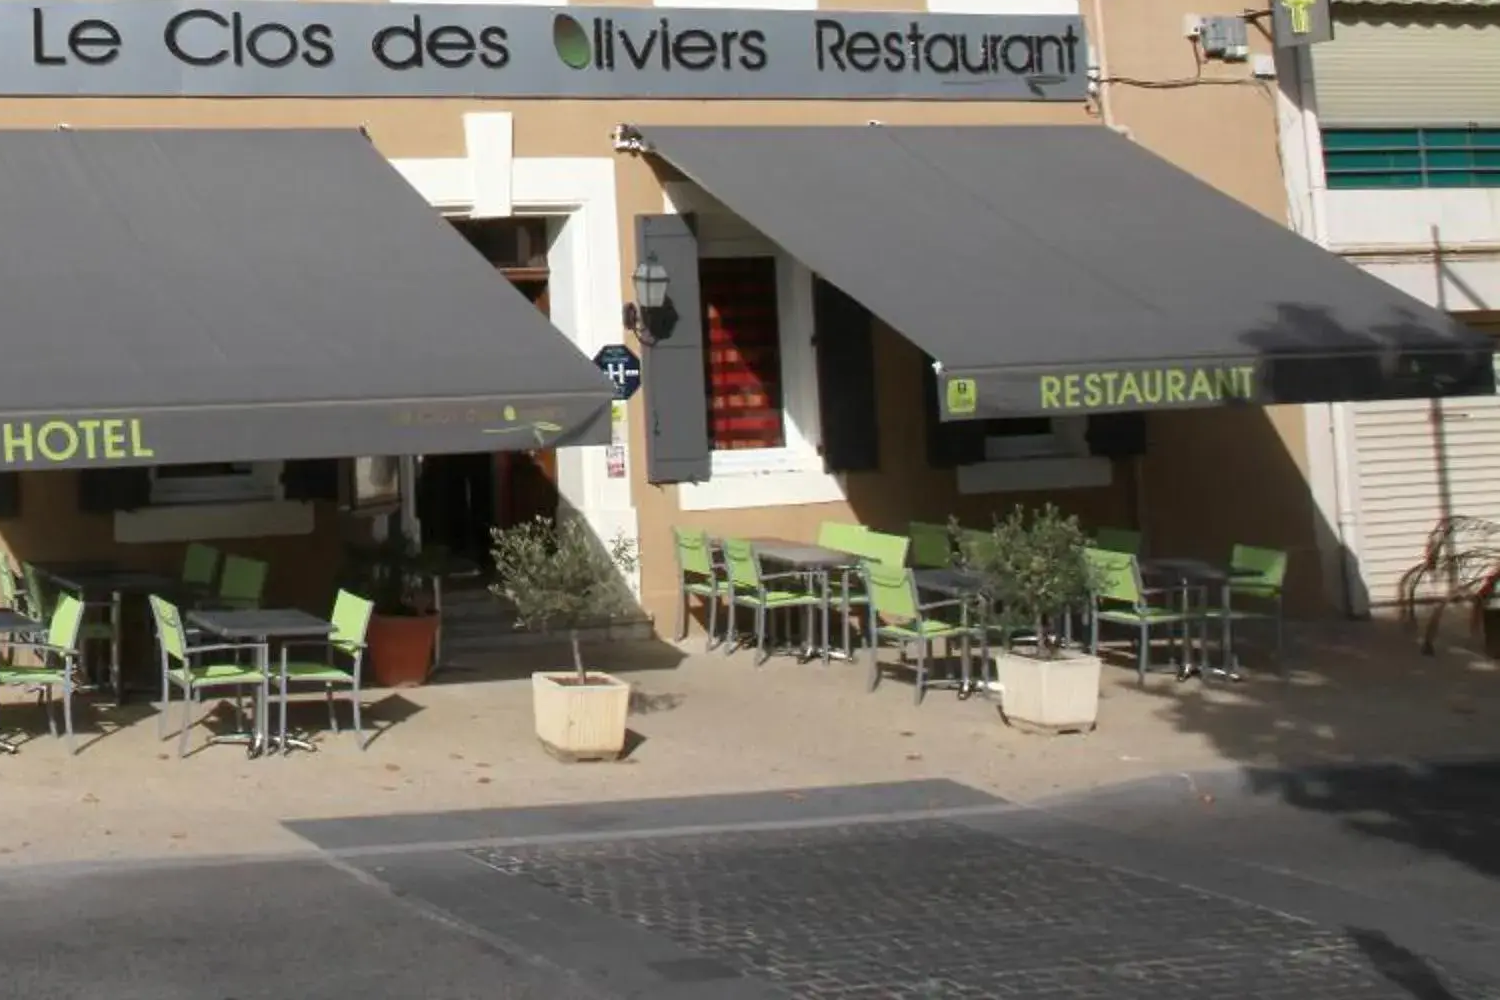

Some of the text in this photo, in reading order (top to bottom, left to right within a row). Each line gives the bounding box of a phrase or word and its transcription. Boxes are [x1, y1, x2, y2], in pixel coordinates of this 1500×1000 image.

[33, 7, 121, 67] Le
[164, 8, 334, 69] Clos
[372, 14, 510, 70] des
[815, 18, 1079, 76] Restaurant
[1040, 366, 1255, 409] RESTAURANT
[3, 418, 154, 463] HOTEL
